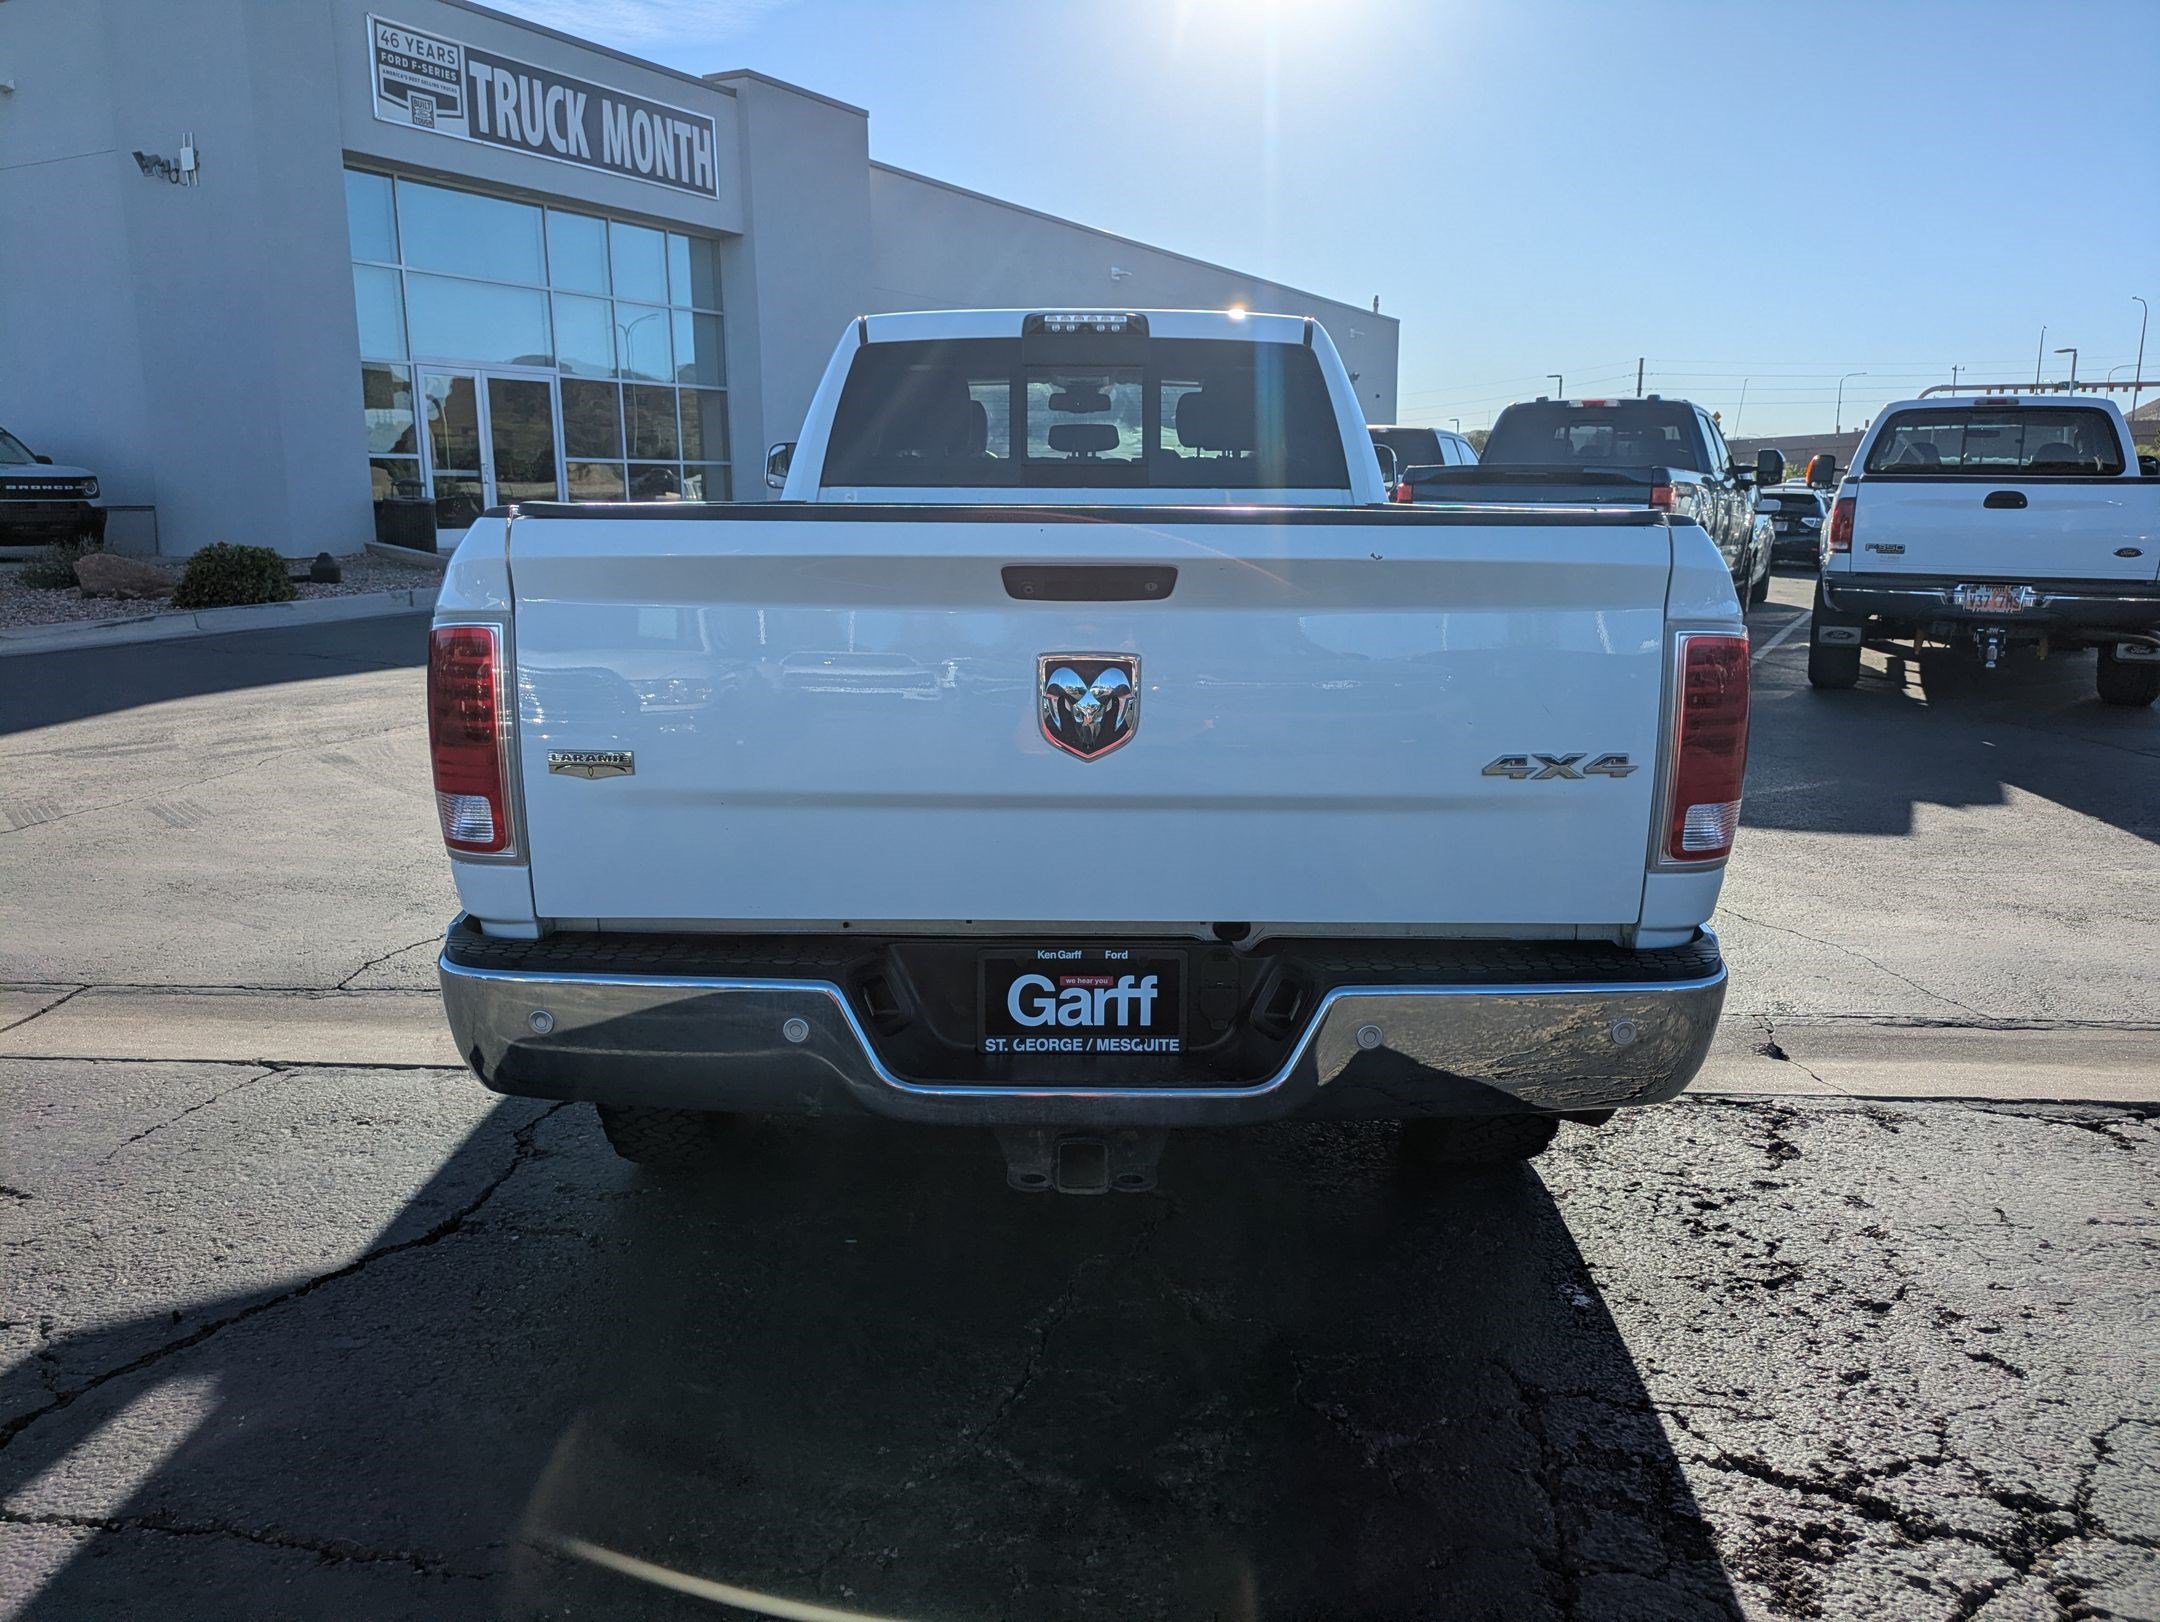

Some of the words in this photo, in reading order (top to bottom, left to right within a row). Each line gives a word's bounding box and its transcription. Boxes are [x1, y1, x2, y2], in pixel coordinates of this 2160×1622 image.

[381, 30, 399, 49] 46
[405, 36, 456, 64] YEARS
[381, 52, 408, 68] FORD
[411, 60, 457, 82] F-SERIES
[413, 99, 431, 110] BUILT
[469, 60, 591, 159] TRUCK
[602, 99, 714, 190] MONTH
[551, 753, 629, 762] LARAMIE
[1481, 752, 1639, 780] 4X4
[1037, 950, 1057, 960] Ken
[1057, 950, 1082, 960] Garff
[1105, 950, 1129, 960] Ford
[1077, 977, 1093, 985] hear
[1094, 978, 1108, 986] you
[1007, 973, 1158, 1027] Garff
[985, 1038, 1008, 1052] ST.
[1012, 1038, 1083, 1052] GEORGE
[1086, 1038, 1093, 1052] /
[1096, 1038, 1180, 1052] MESQUITE
